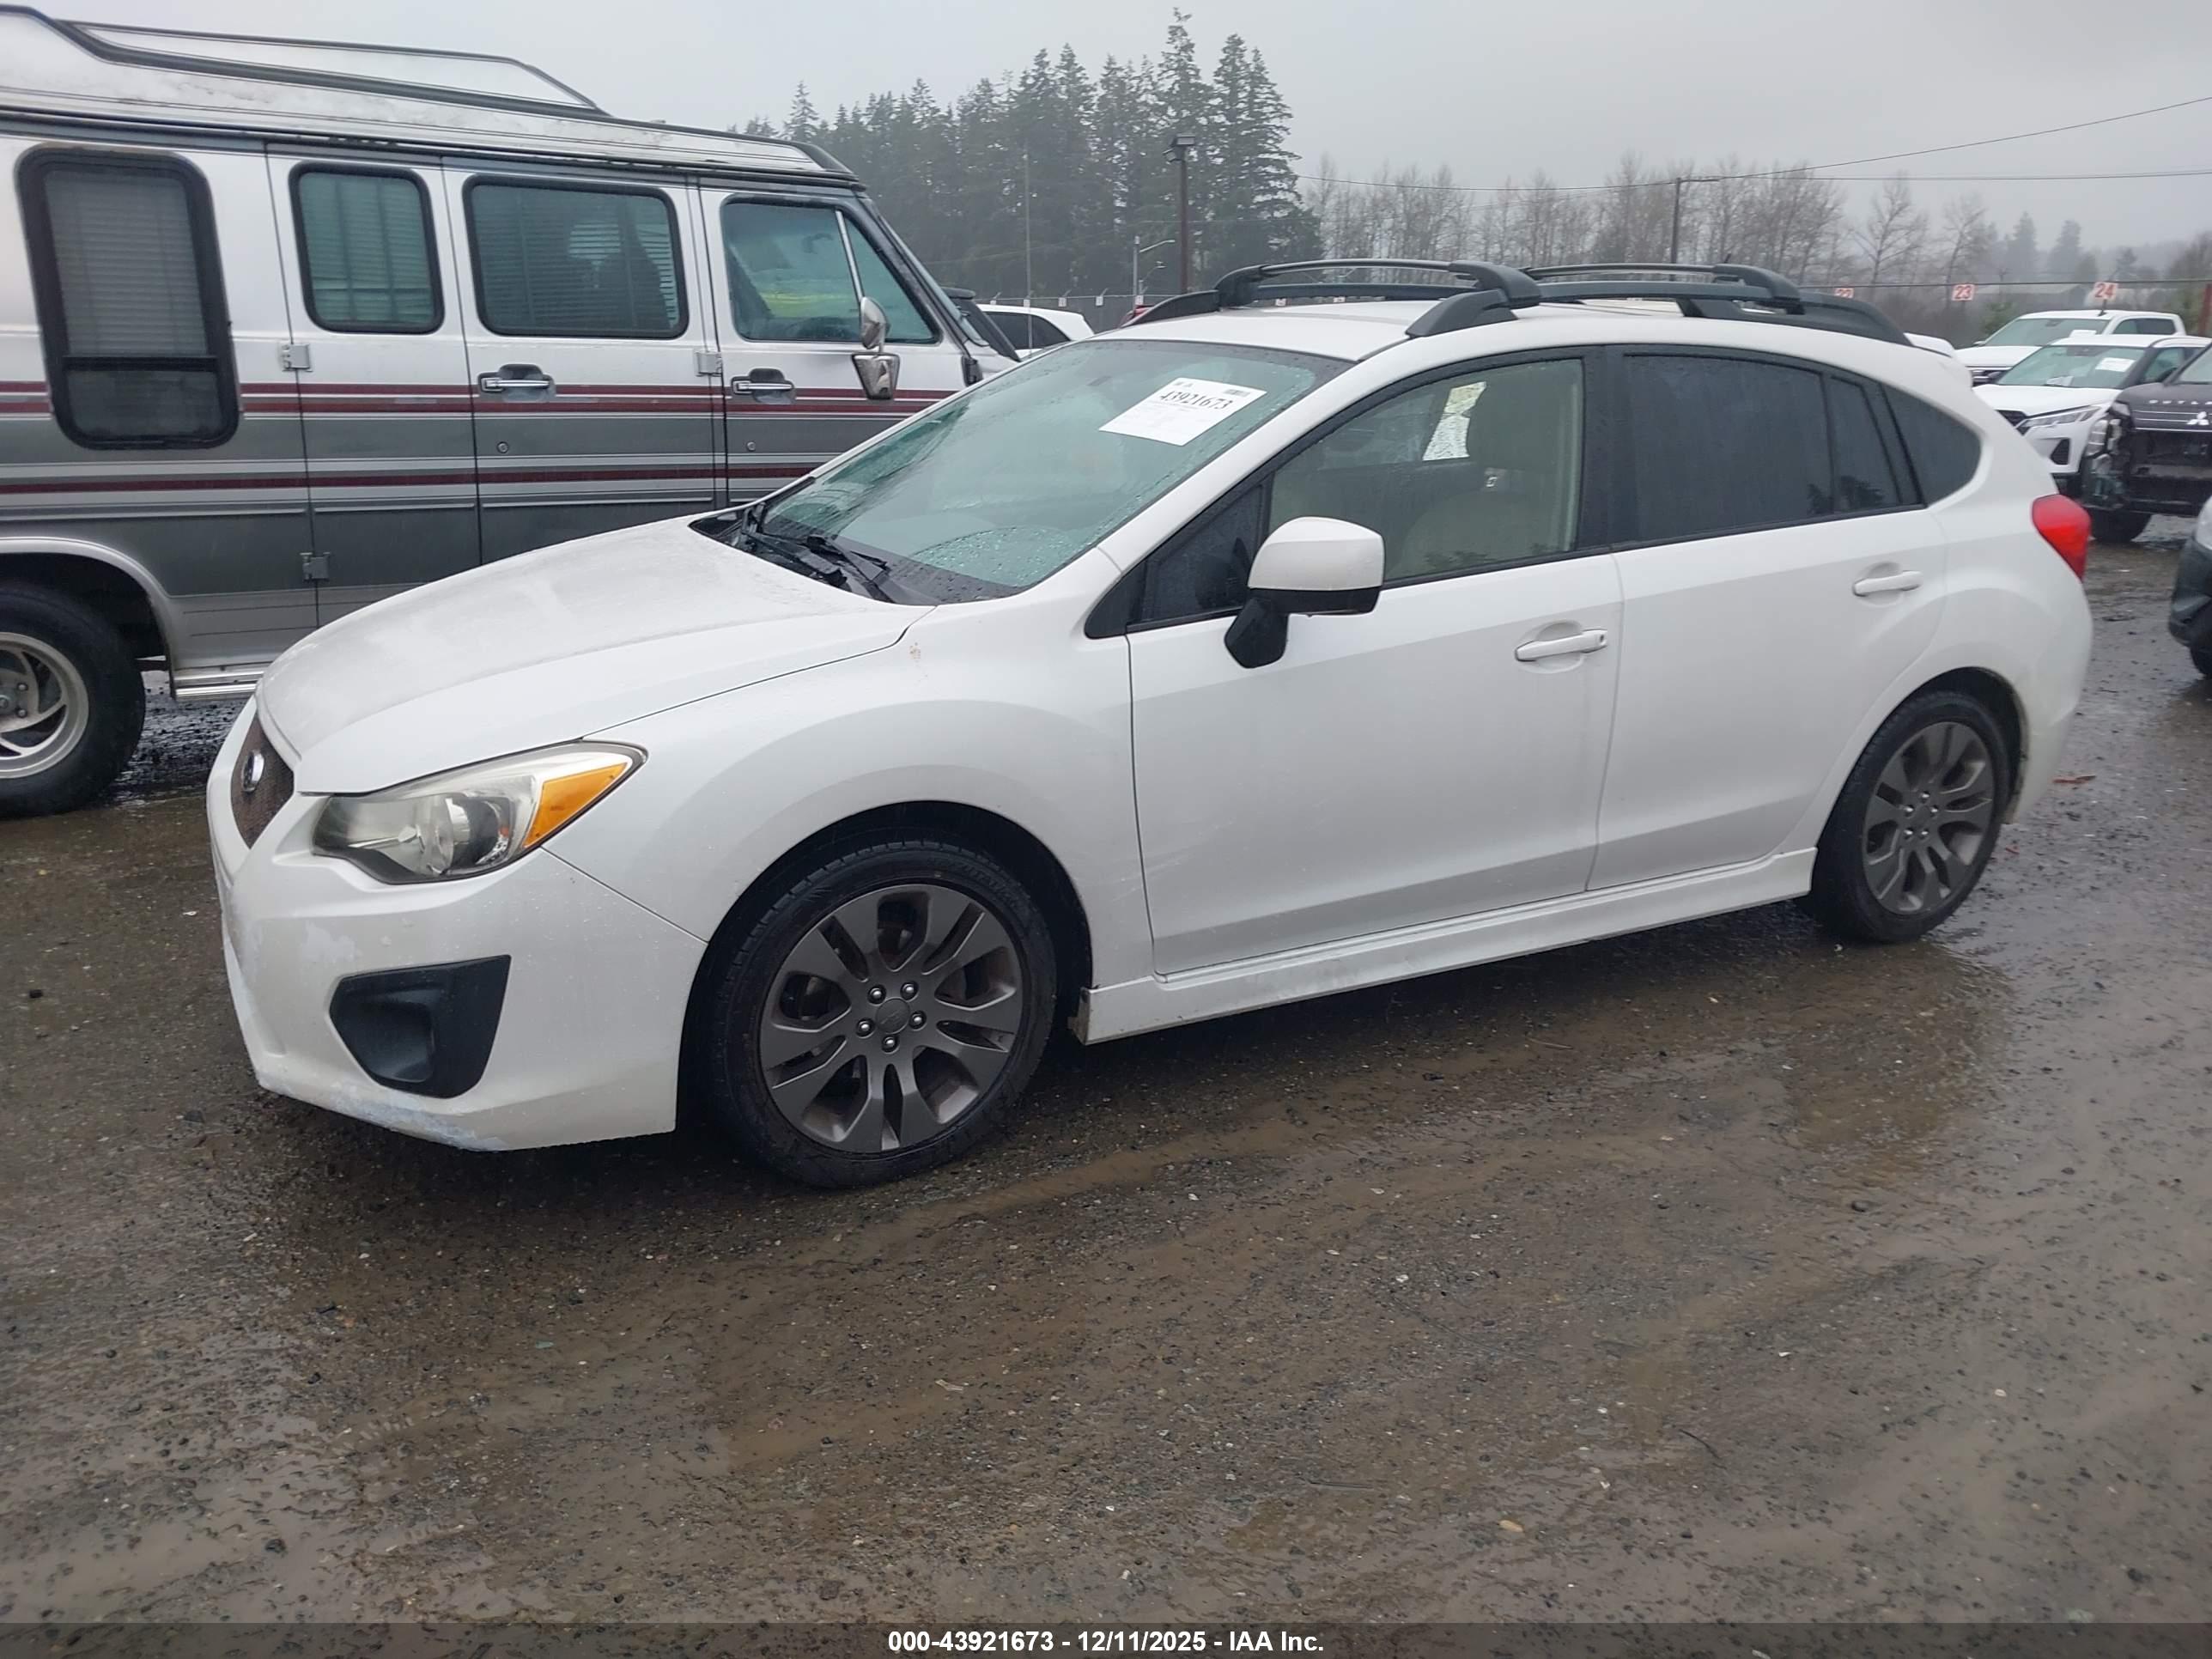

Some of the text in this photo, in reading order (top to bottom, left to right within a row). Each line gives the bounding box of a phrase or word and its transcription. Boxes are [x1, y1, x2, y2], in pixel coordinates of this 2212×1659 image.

[1954, 284, 1973, 300] 23
[2094, 283, 2116, 299] 24
[1160, 390, 1234, 410] 43921673
